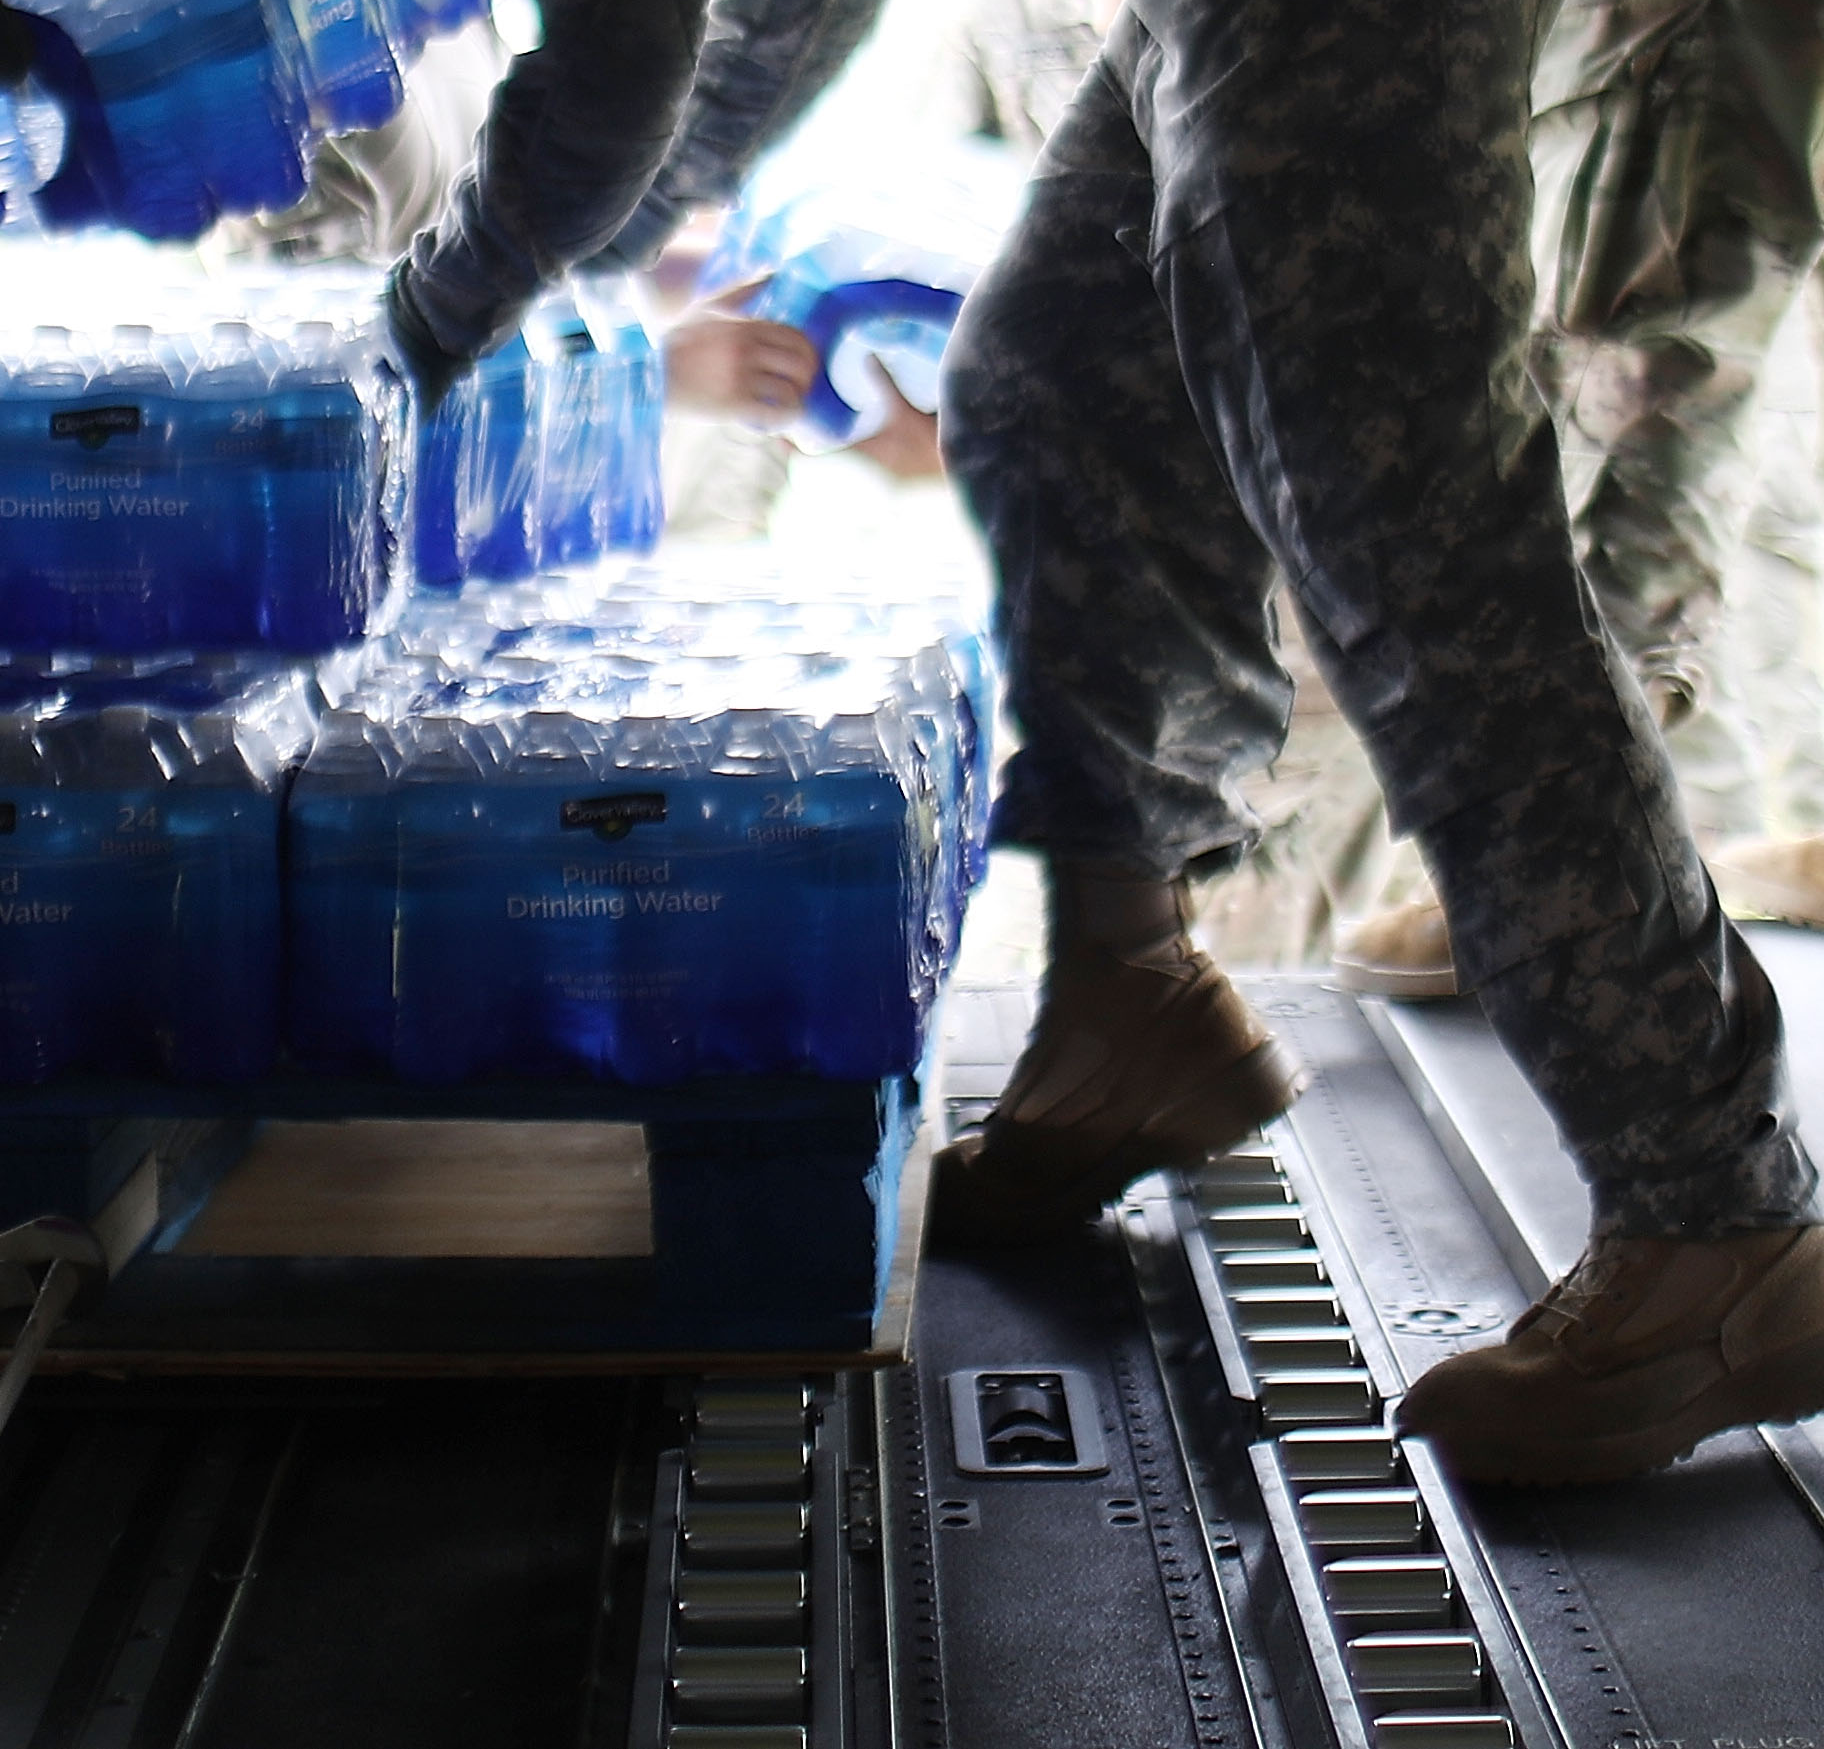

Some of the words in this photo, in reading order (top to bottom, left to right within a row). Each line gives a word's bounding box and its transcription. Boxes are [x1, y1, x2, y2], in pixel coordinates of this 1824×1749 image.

[230, 407, 266, 434] 24
[49, 467, 142, 492] Purified
[107, 493, 189, 518] Water
[115, 805, 159, 834] 24
[761, 791, 806, 820] 24
[747, 824, 821, 844] Bottles
[562, 859, 671, 888] Purified
[506, 893, 626, 920] Drinking
[635, 889, 723, 914] Water
